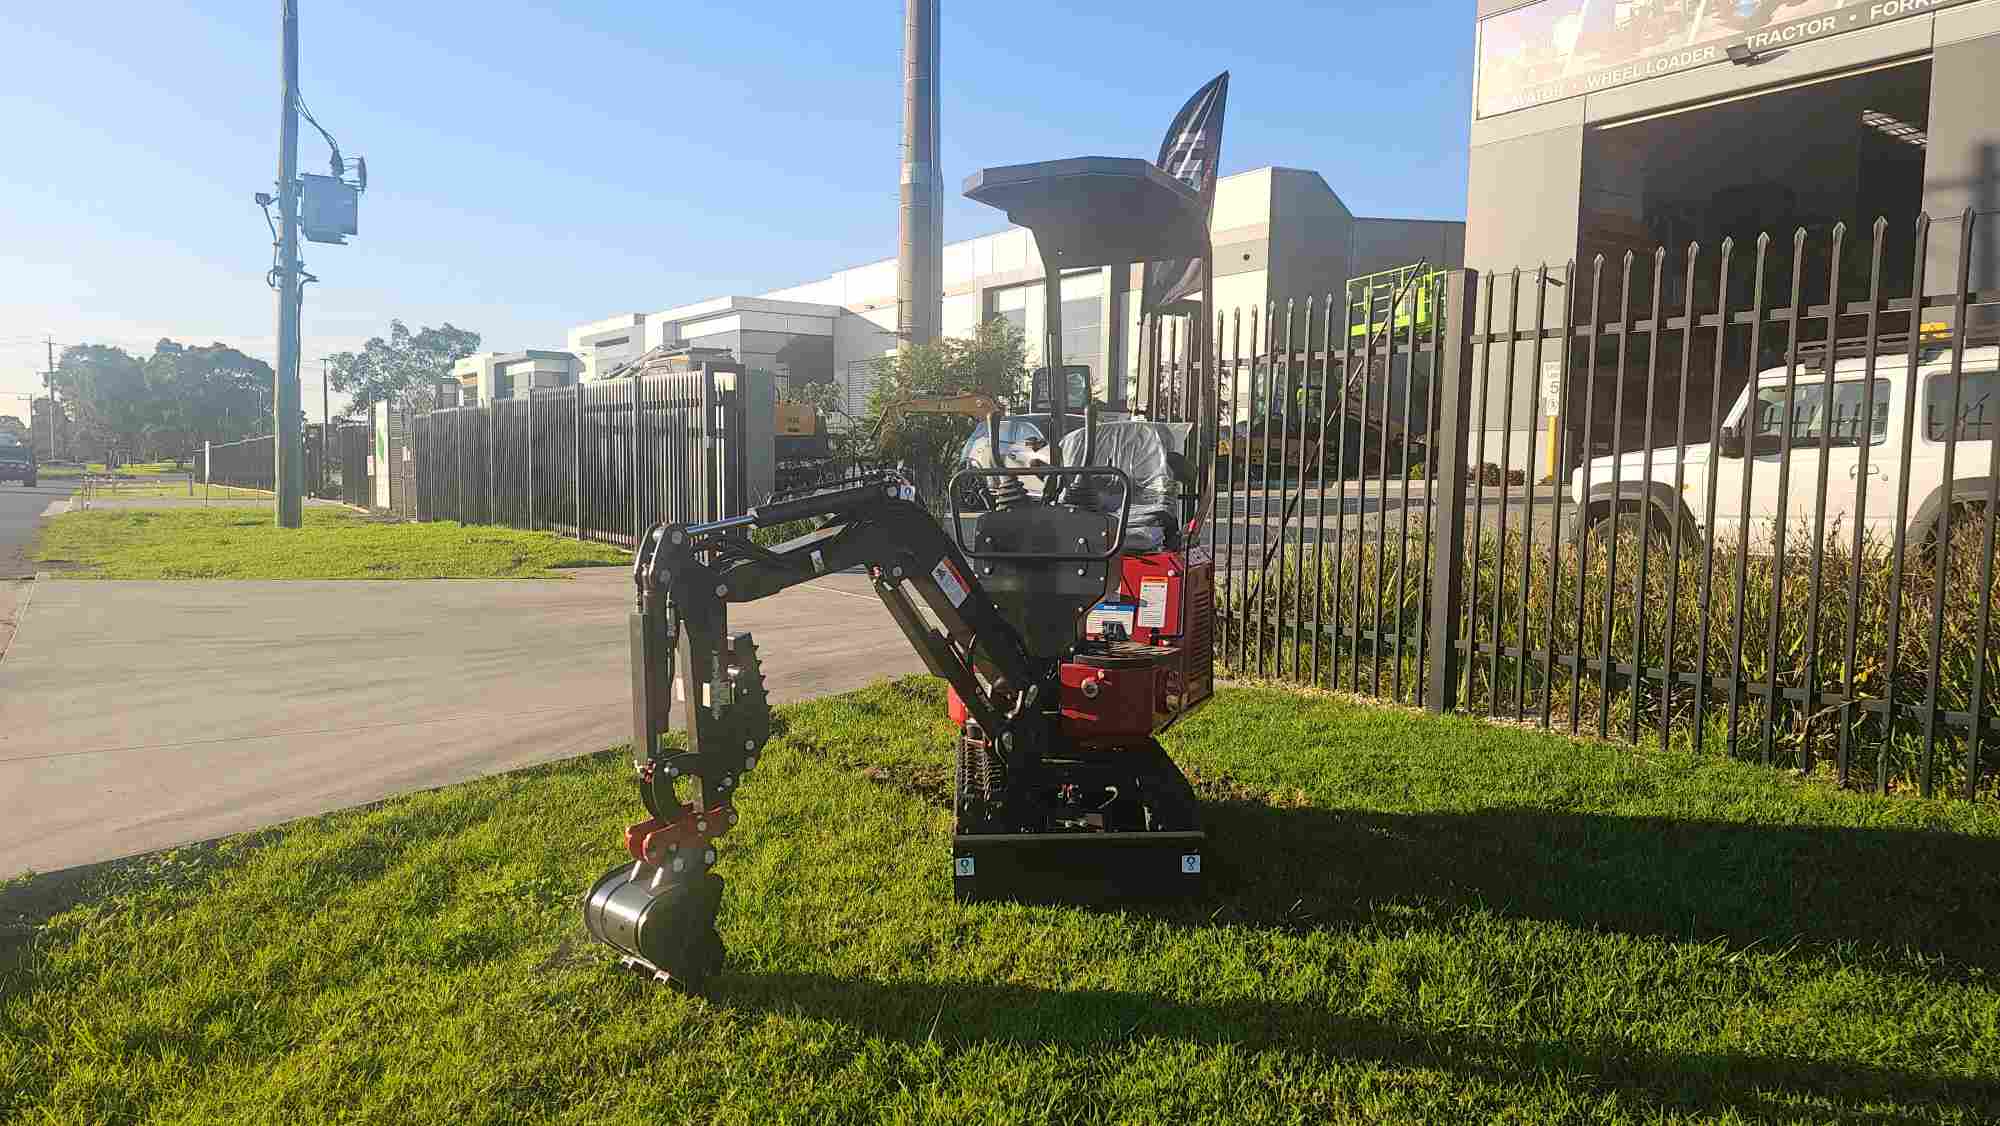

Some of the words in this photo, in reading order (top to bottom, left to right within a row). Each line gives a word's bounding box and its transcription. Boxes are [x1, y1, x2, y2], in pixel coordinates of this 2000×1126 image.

[1584, 65, 1640, 89] WHEEL
[1645, 45, 1716, 74] LOADER
[1744, 16, 1836, 49] TRACTOR
